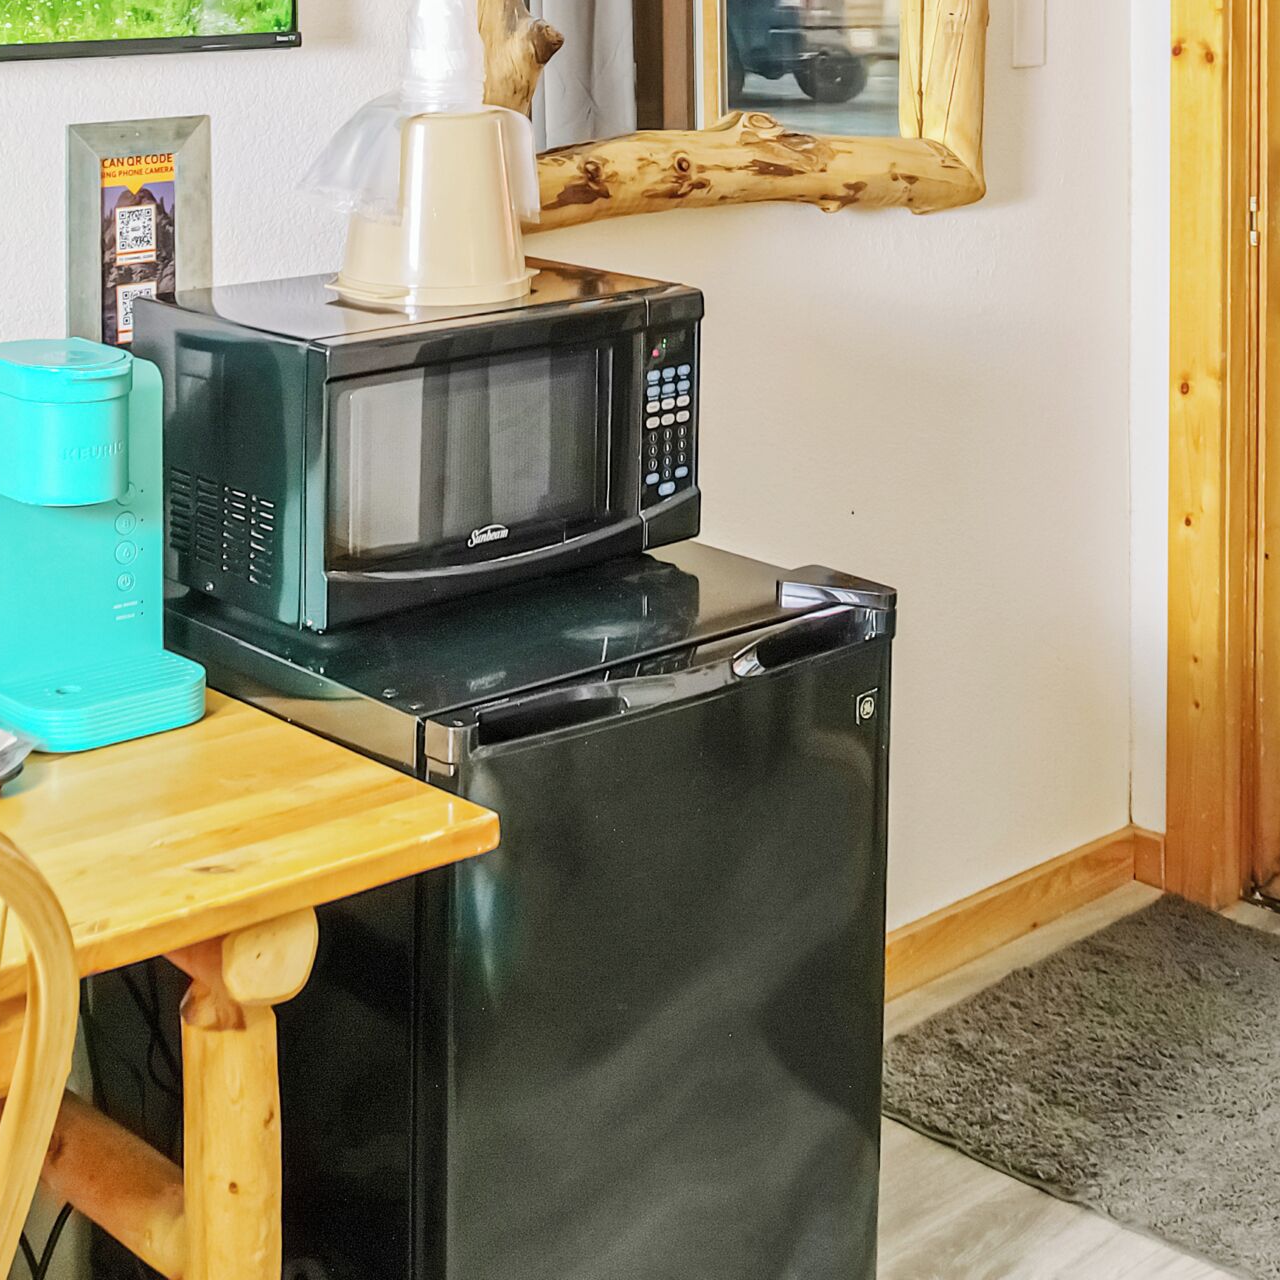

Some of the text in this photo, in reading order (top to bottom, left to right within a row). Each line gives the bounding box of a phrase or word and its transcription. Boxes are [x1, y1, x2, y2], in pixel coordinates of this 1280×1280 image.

[102, 153, 173, 168] CAN QR CODE
[118, 169, 144, 177] PHONE
[145, 166, 174, 175] CAMERA
[467, 525, 509, 548] Sunbeam
